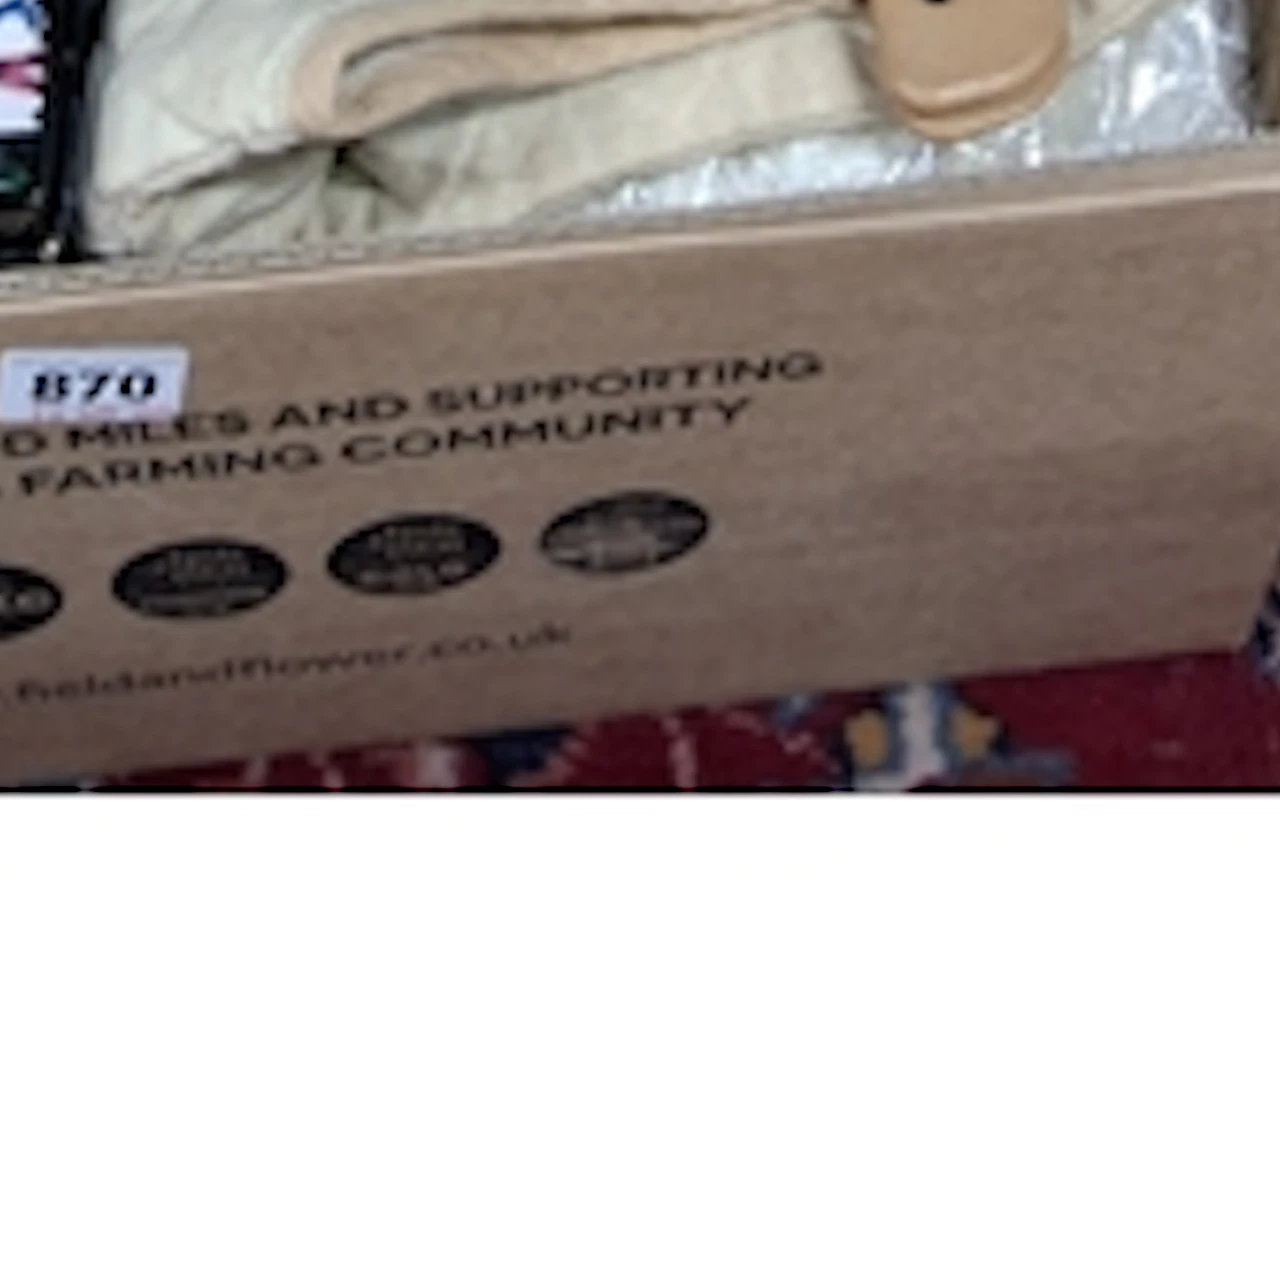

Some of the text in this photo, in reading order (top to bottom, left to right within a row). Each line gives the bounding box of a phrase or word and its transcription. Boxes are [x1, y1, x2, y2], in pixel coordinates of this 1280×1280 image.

[31, 368, 157, 403] 870
[66, 407, 250, 451] MILES
[271, 390, 410, 432] AND
[425, 350, 825, 415] SUPPORTING
[18, 440, 323, 499] FARMING
[337, 395, 752, 467] COMMUNITY
